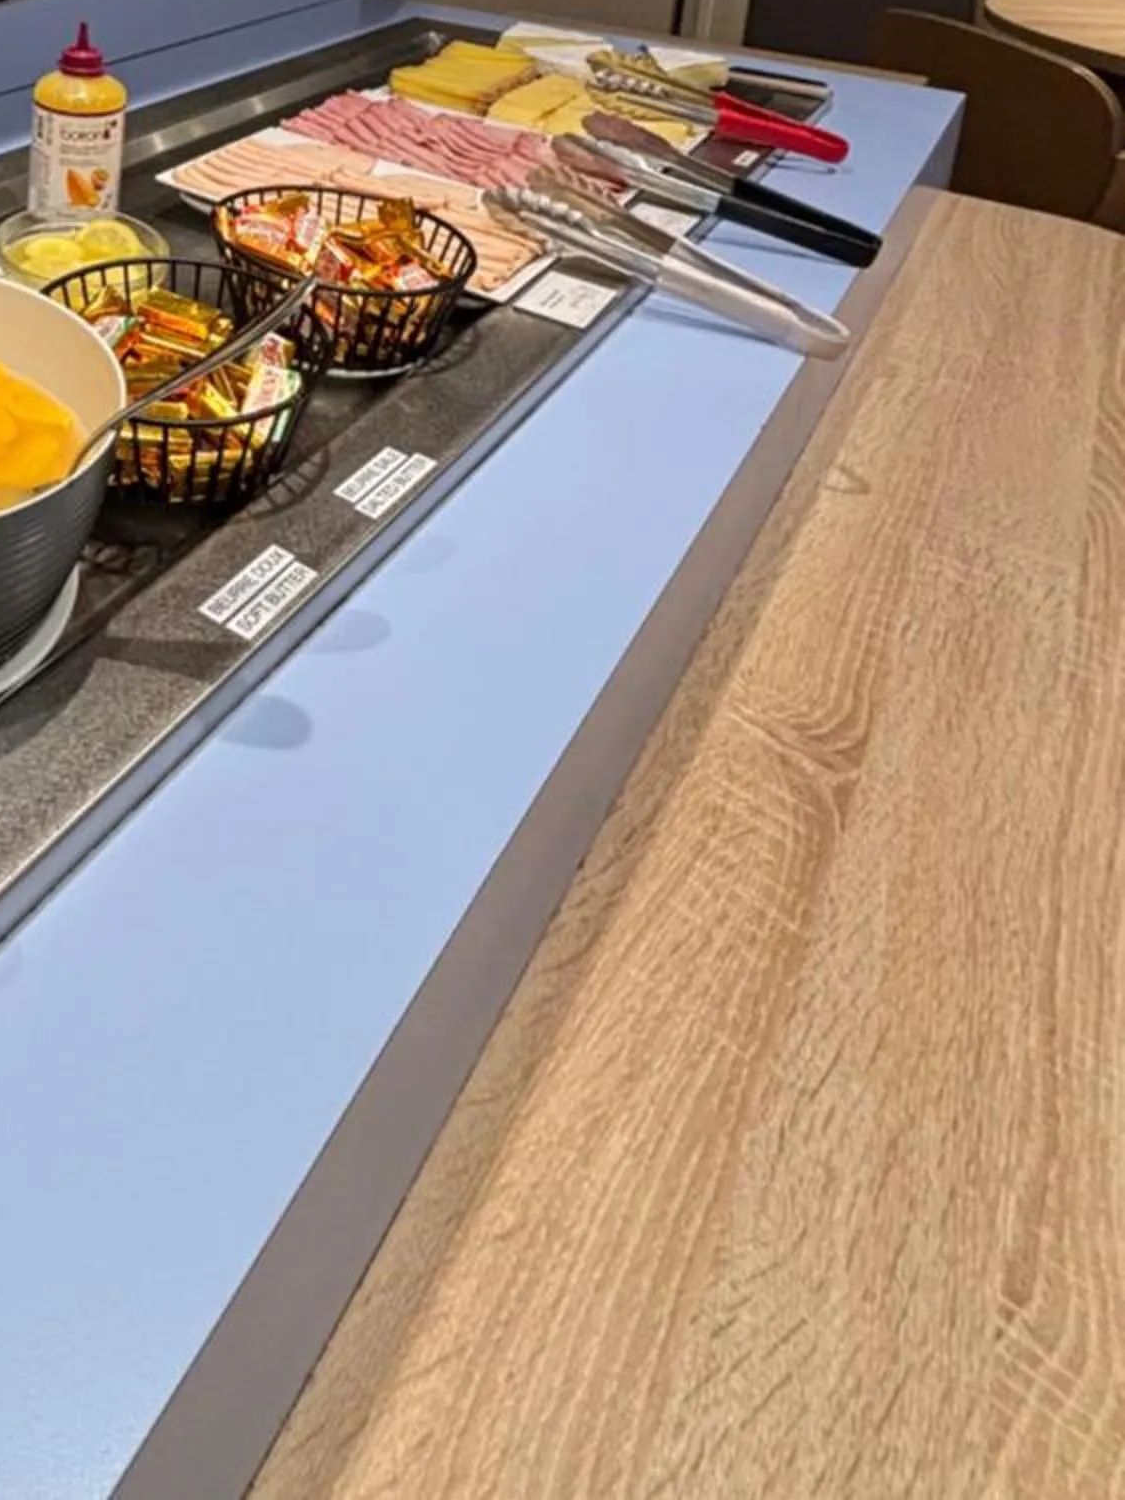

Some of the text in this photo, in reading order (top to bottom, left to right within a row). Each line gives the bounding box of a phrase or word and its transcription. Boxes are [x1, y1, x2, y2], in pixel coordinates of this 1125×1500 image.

[206, 549, 286, 617] BEURRE DOUX
[235, 565, 309, 633] SOFT BUTTER
